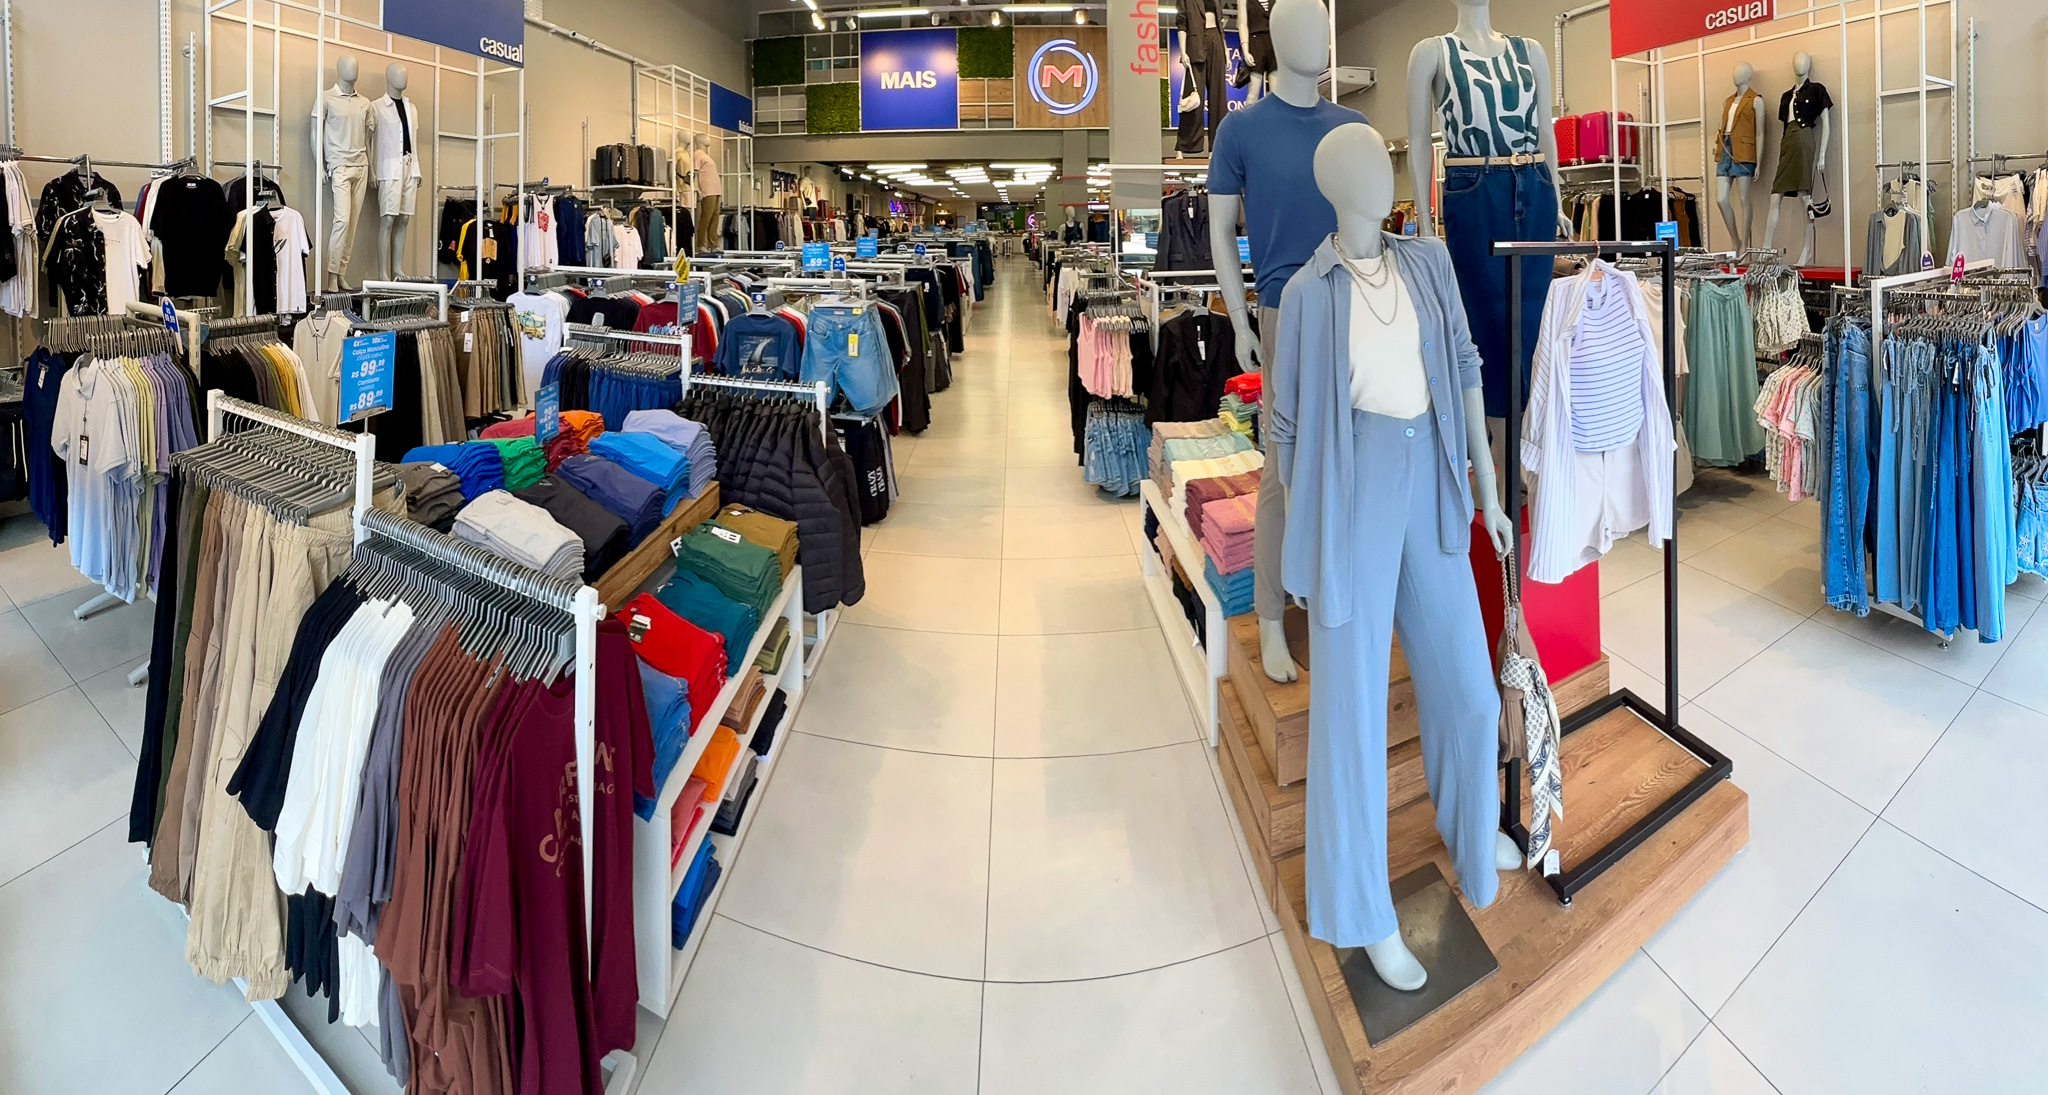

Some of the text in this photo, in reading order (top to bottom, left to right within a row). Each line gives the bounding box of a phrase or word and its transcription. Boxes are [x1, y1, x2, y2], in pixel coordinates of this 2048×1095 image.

[1705, 0, 1768, 30] casual
[479, 36, 523, 63] casual
[880, 70, 937, 90] MAIS
[1041, 64, 1084, 88] M
